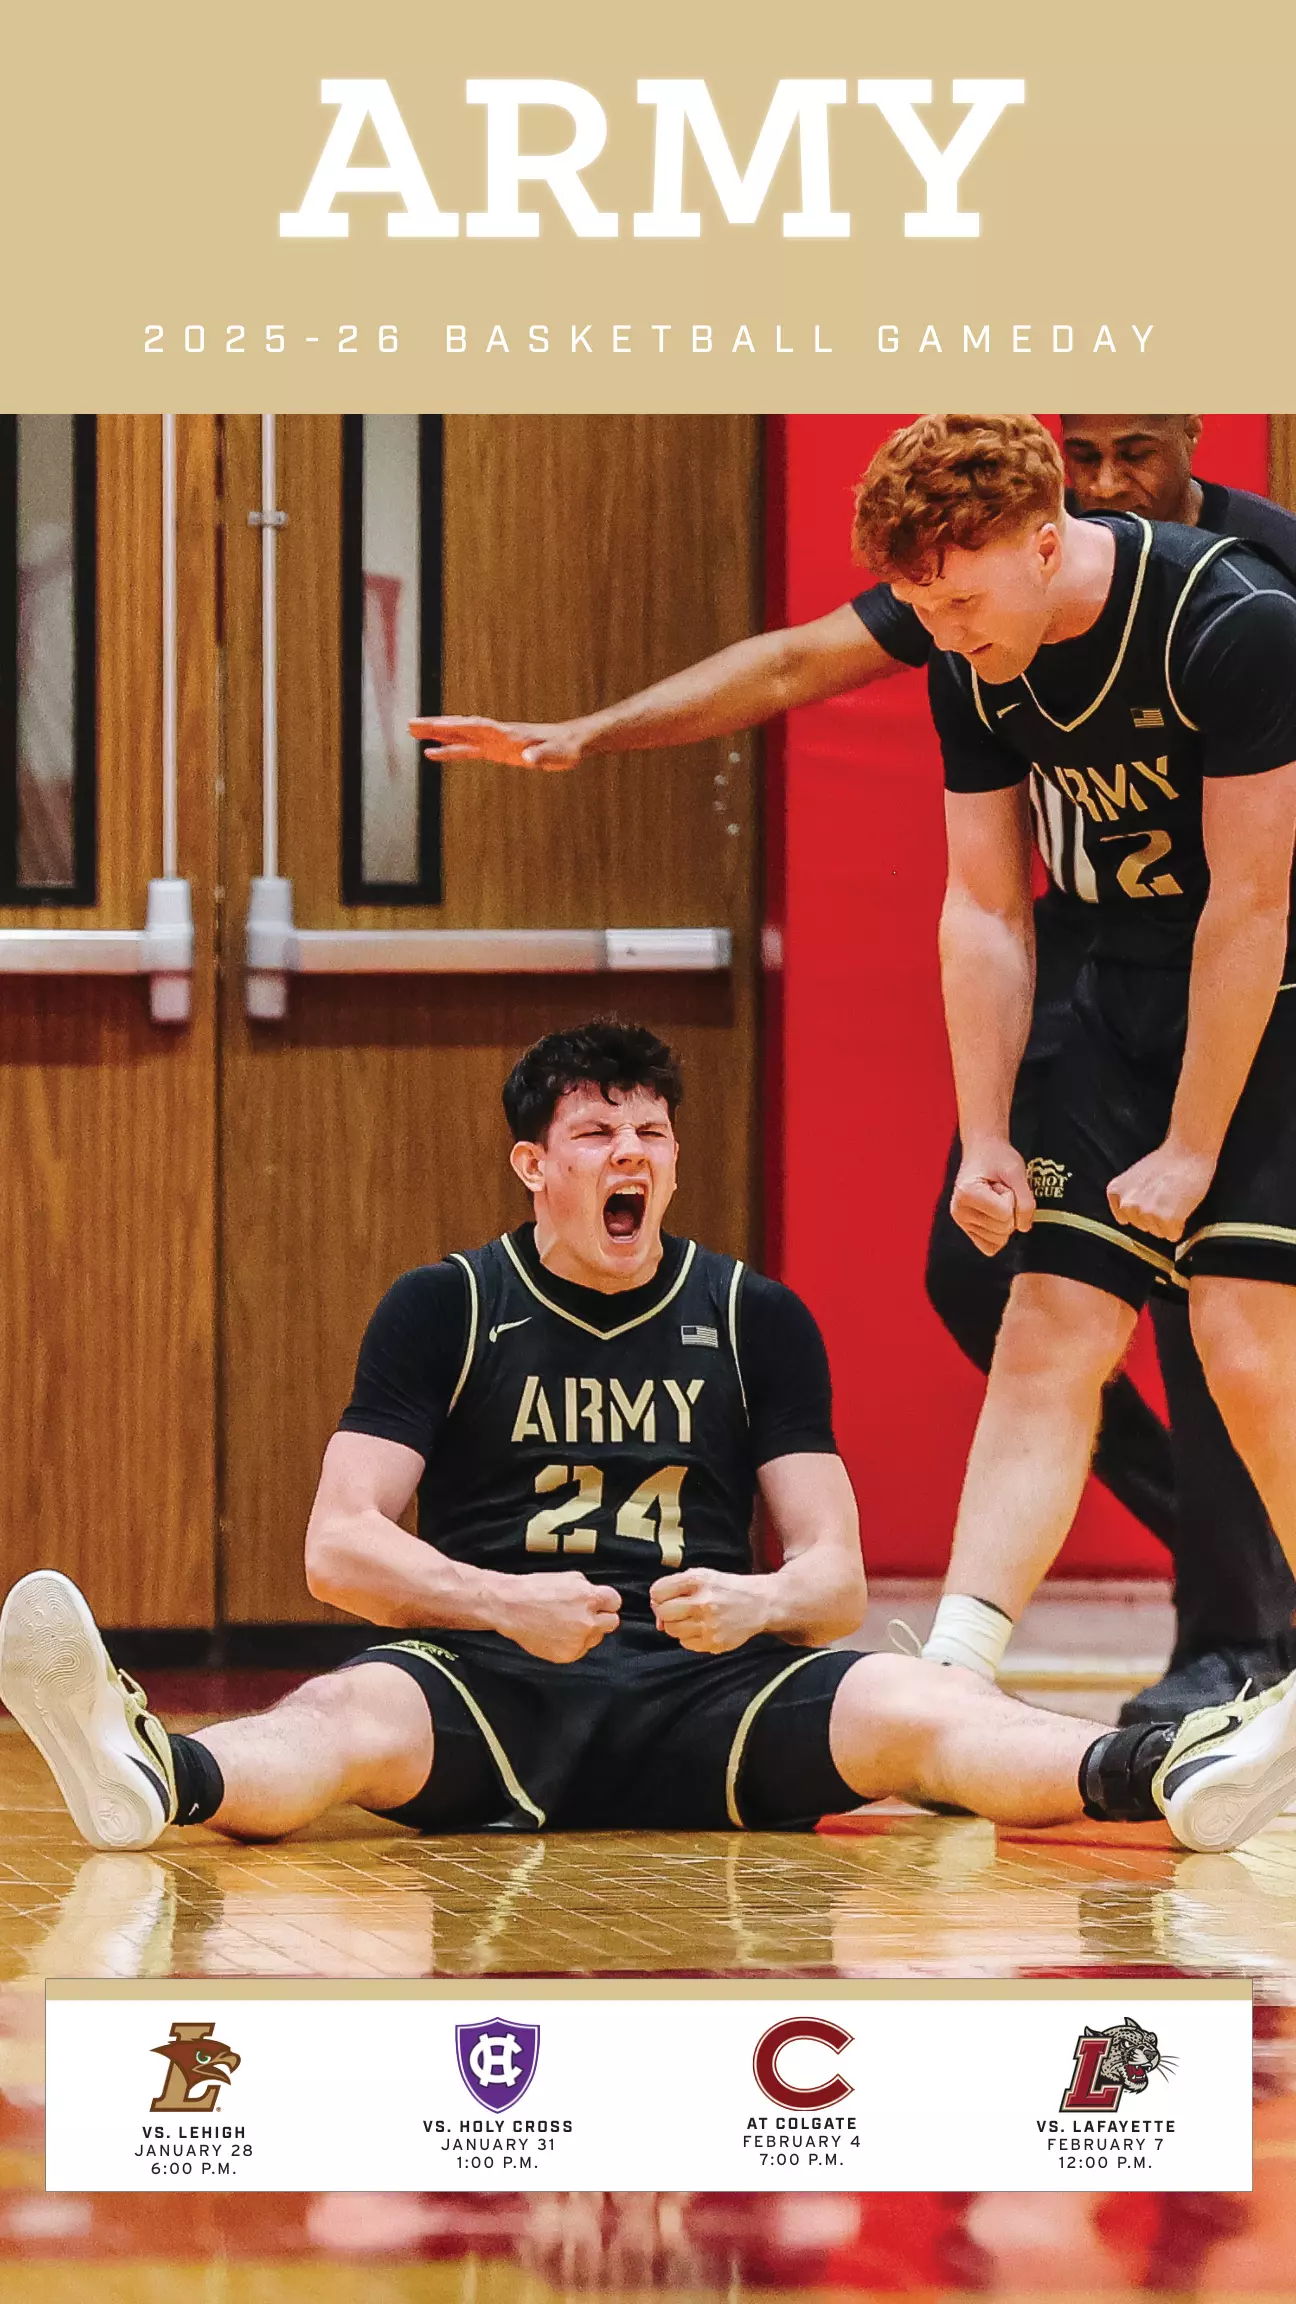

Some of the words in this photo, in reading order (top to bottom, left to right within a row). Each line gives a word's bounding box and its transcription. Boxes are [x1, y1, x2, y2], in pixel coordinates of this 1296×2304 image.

[1032, 755, 1179, 822] RMY
[511, 1375, 705, 1443] ARMY
[525, 1464, 685, 1568] 24
